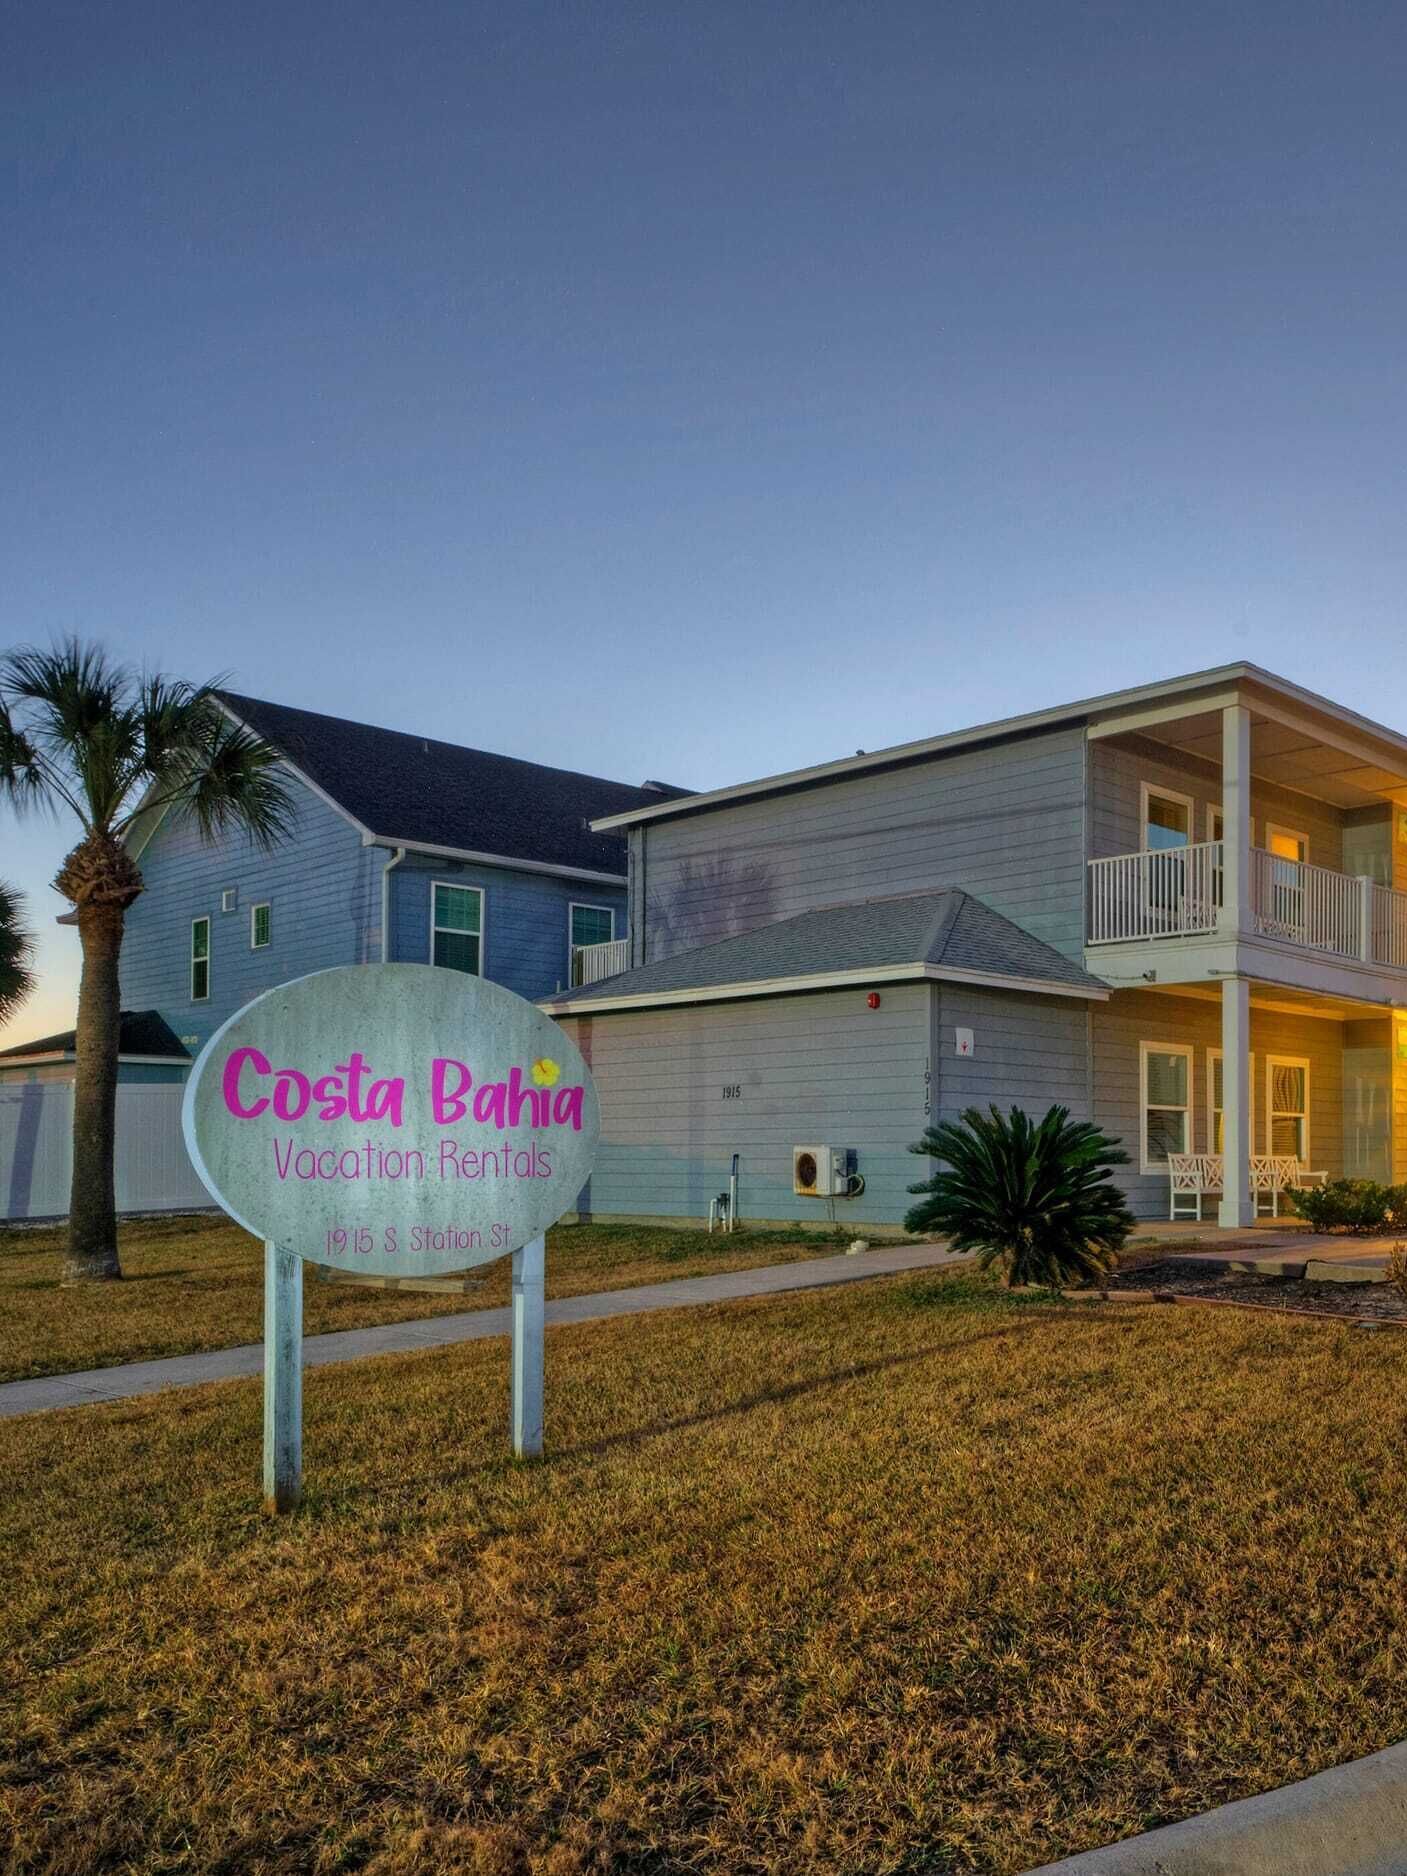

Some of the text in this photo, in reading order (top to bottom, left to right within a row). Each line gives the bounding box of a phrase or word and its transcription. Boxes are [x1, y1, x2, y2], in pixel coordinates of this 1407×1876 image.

[222, 1046, 585, 1132] Costa Bahia
[722, 1085, 741, 1099] 1915
[273, 1137, 552, 1180] Vacation Rentals
[327, 1223, 511, 1256] 1915 S Station St
